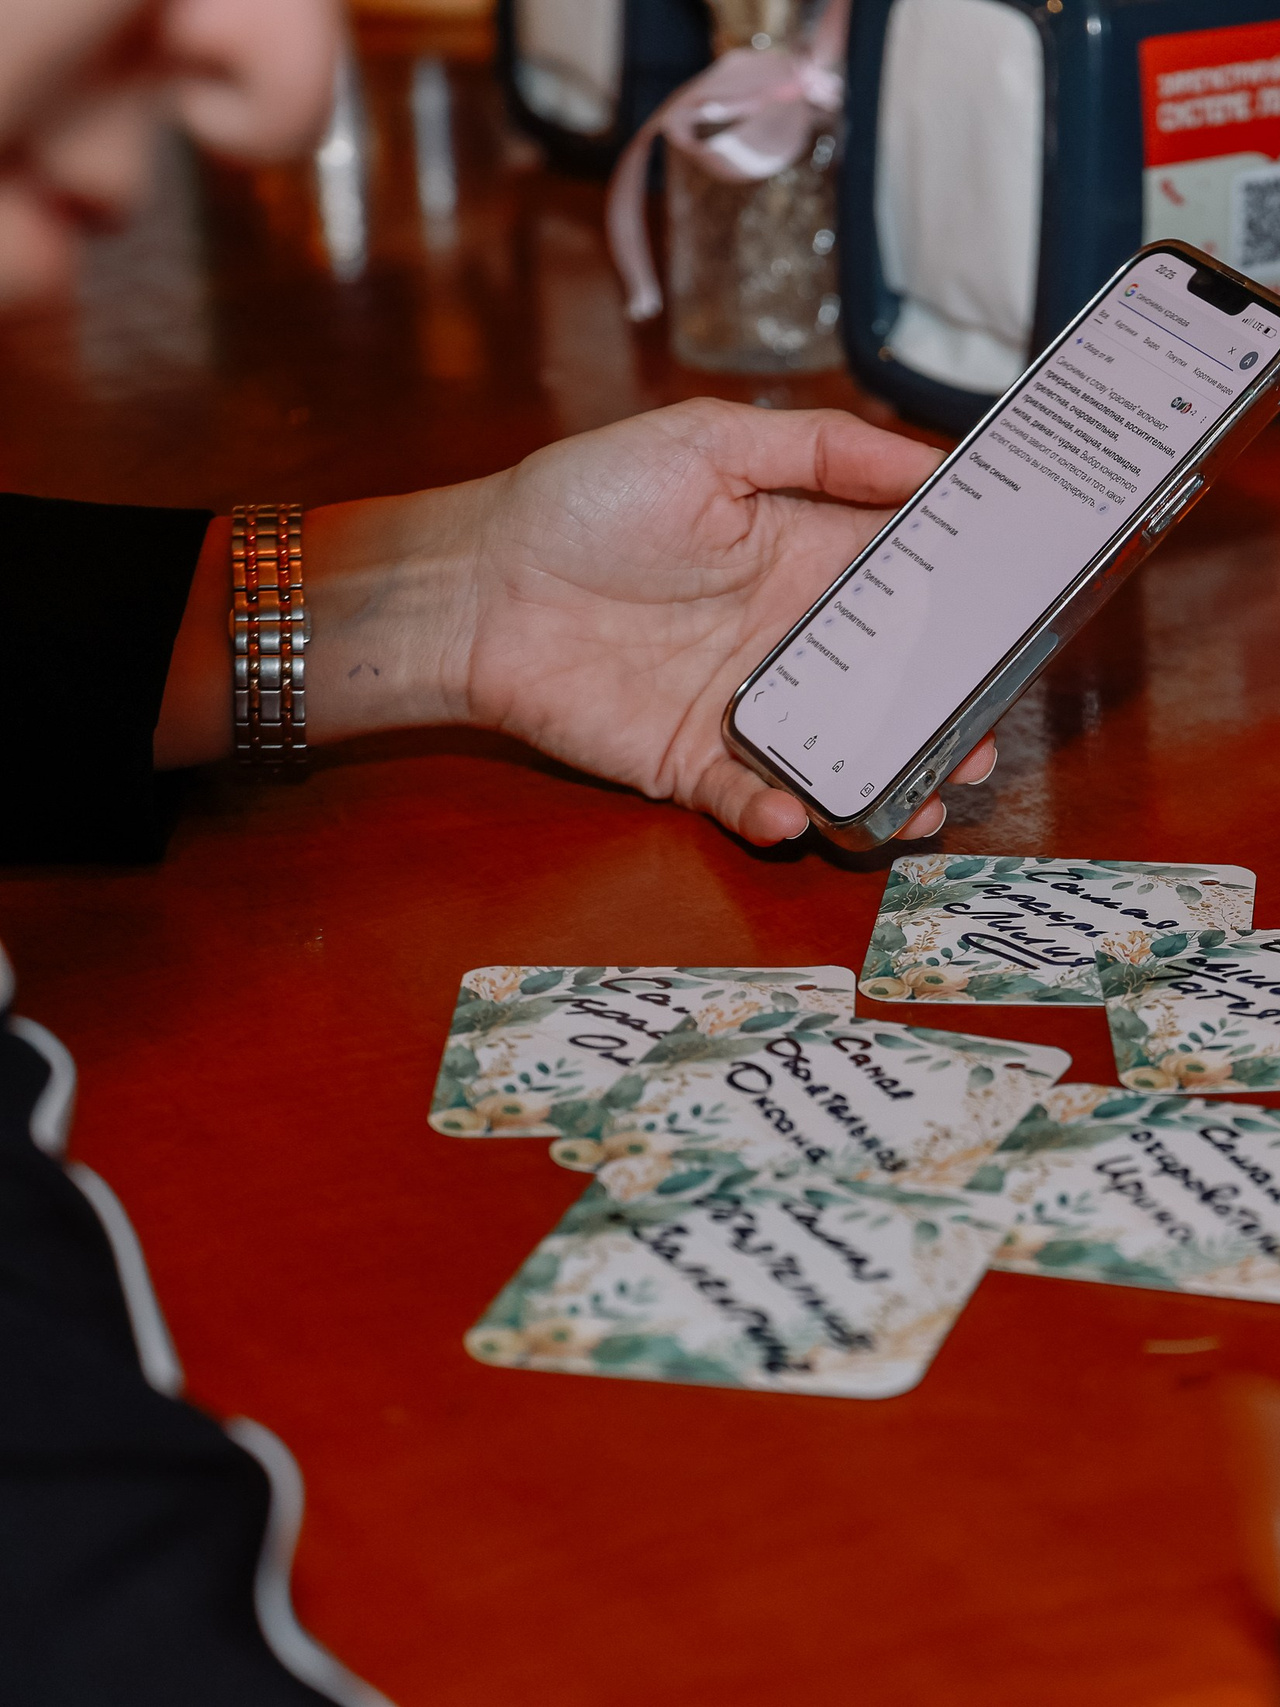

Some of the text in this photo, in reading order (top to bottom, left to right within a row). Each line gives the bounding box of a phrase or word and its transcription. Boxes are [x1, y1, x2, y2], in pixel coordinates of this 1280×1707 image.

[1155, 264, 1176, 279] 20:25
[1099, 309, 1109, 319] Все
[1136, 293, 1189, 326] синонимы красивая
[1252, 321, 1264, 331] LTE
[1114, 320, 1138, 336] Картинки
[1143, 337, 1160, 350] Видео
[1083, 342, 1099, 355] Обзор
[1103, 355, 1115, 363] ИИ
[1165, 350, 1187, 367] Покупки
[1056, 356, 1086, 379] Синонимы
[1089, 379, 1108, 394] слову
[1109, 388, 1140, 411] "красивая"
[1137, 409, 1168, 431] включают
[1193, 367, 1233, 395] Короткие видео
[1033, 382, 1118, 441] прелестная, очаровательная,
[1045, 370, 1175, 458] прекрасная, великолепная, восхитительная,
[1012, 406, 1031, 423] милая,
[1030, 420, 1054, 436] дивная
[1058, 437, 1080, 455] чудная.
[1079, 450, 1100, 469] Выбор
[1099, 465, 1137, 493] конкретного
[1023, 394, 1140, 476] привлекательная, изящная, миловидная,
[969, 452, 1021, 491] Общие синонимы
[989, 431, 1094, 507] аспект красоты вы хотите подчеркнуть.
[1000, 418, 1029, 440] синонима
[1027, 437, 1052, 454] зависит
[1048, 451, 1060, 460] от
[1057, 457, 1087, 480] контекста
[1091, 479, 1105, 494] того,
[1105, 490, 1125, 505] какой
[950, 474, 982, 499] Прекрасная
[920, 505, 958, 536] Великолепная
[891, 537, 934, 571] Восхитительная
[863, 569, 894, 595] Прелестная
[834, 601, 876, 636] Очаровательная
[805, 633, 849, 671] Привлекательная
[776, 665, 799, 686] Изящная
[972, 883, 1109, 938] прекра
[1025, 871, 1180, 930] Самая
[725, 1061, 829, 1165] Оксана
